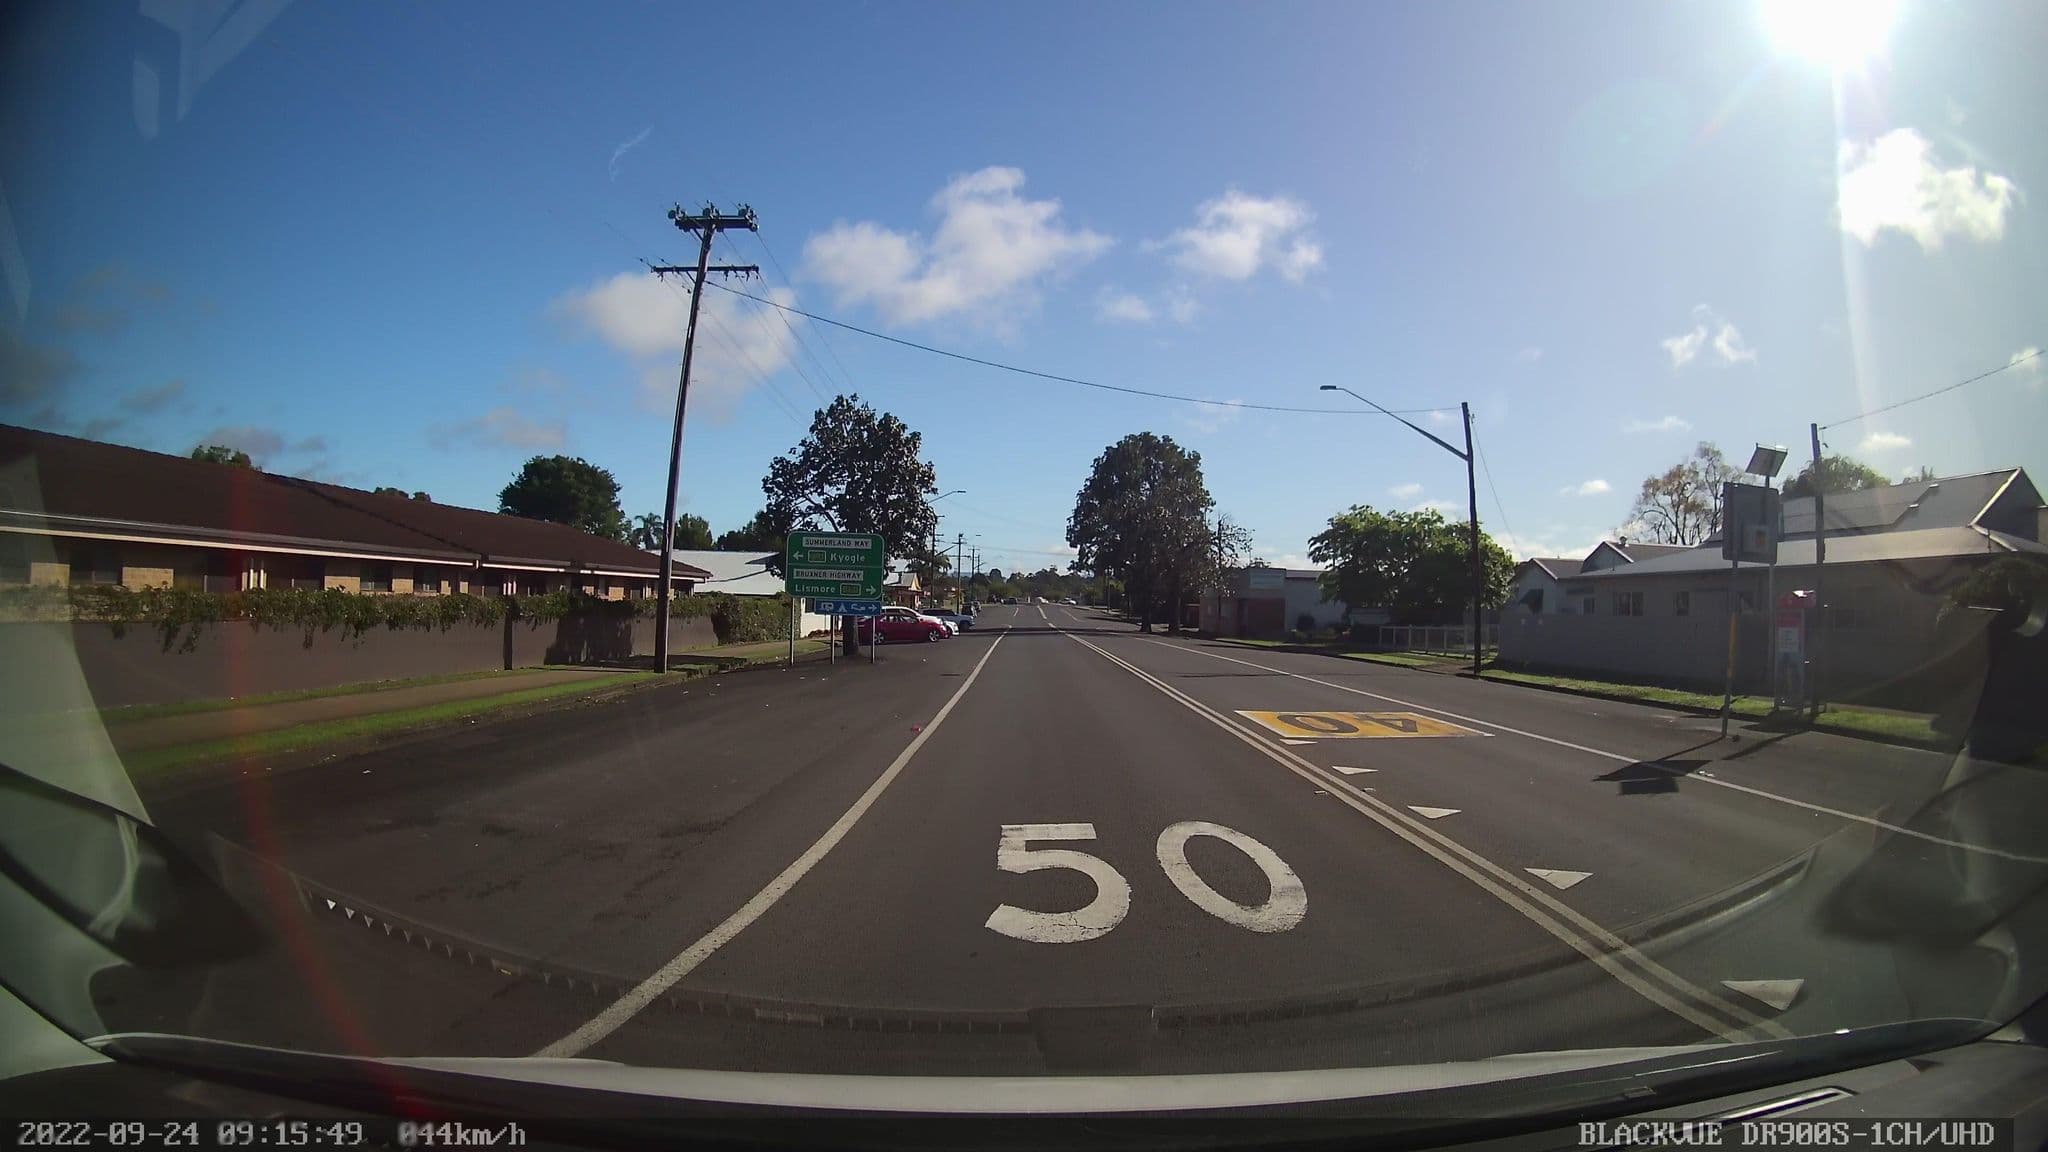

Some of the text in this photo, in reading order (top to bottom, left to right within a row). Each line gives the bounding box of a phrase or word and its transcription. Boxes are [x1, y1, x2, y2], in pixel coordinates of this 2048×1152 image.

[805, 538, 869, 548] SUMMERLAND WAY
[830, 553, 865, 563] Kyogle
[796, 570, 862, 580] BRUXNER HIGHWAY
[795, 584, 836, 593] Lismore
[1276, 713, 1419, 735] 40
[985, 821, 1308, 944] 50
